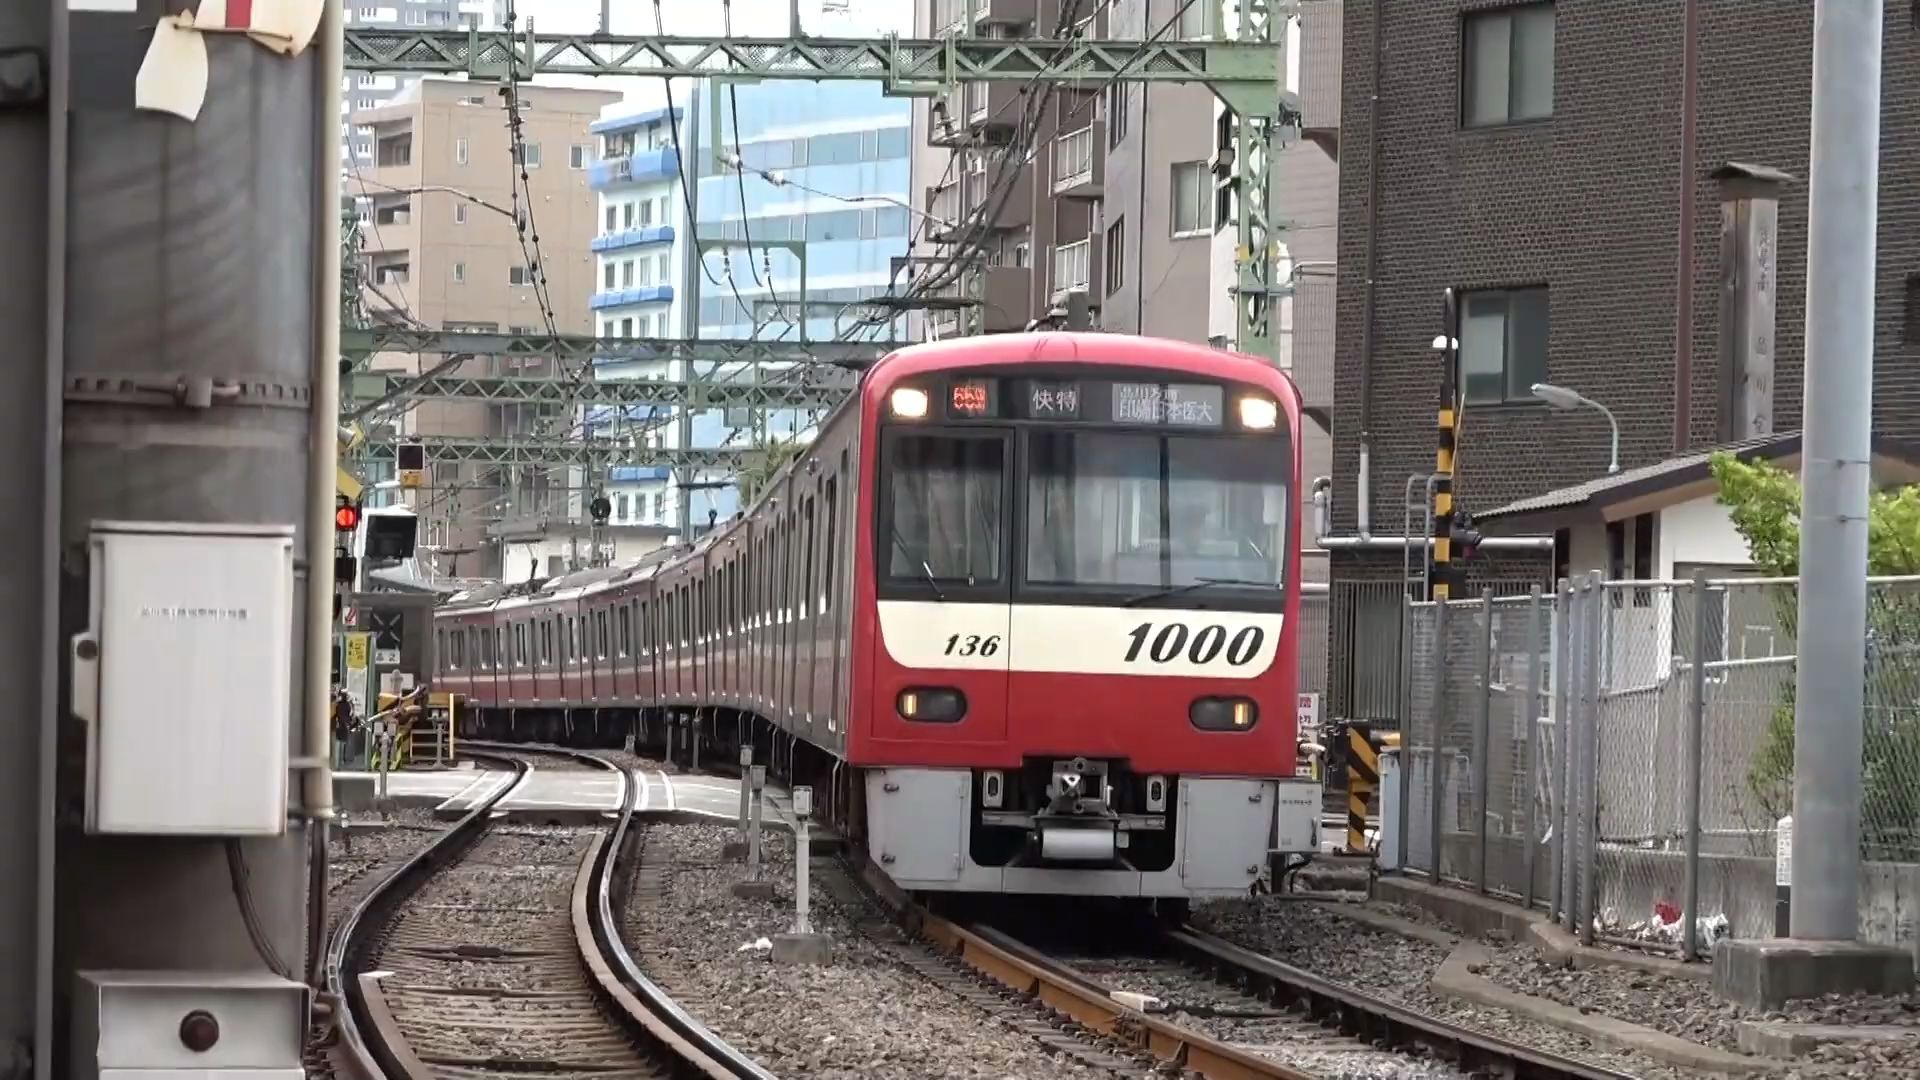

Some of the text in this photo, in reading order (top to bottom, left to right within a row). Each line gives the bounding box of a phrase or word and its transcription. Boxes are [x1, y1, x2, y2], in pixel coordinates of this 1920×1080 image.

[1032, 388, 1078, 413] 快特
[944, 632, 1001, 657] 136
[1124, 621, 1265, 666] 1000
